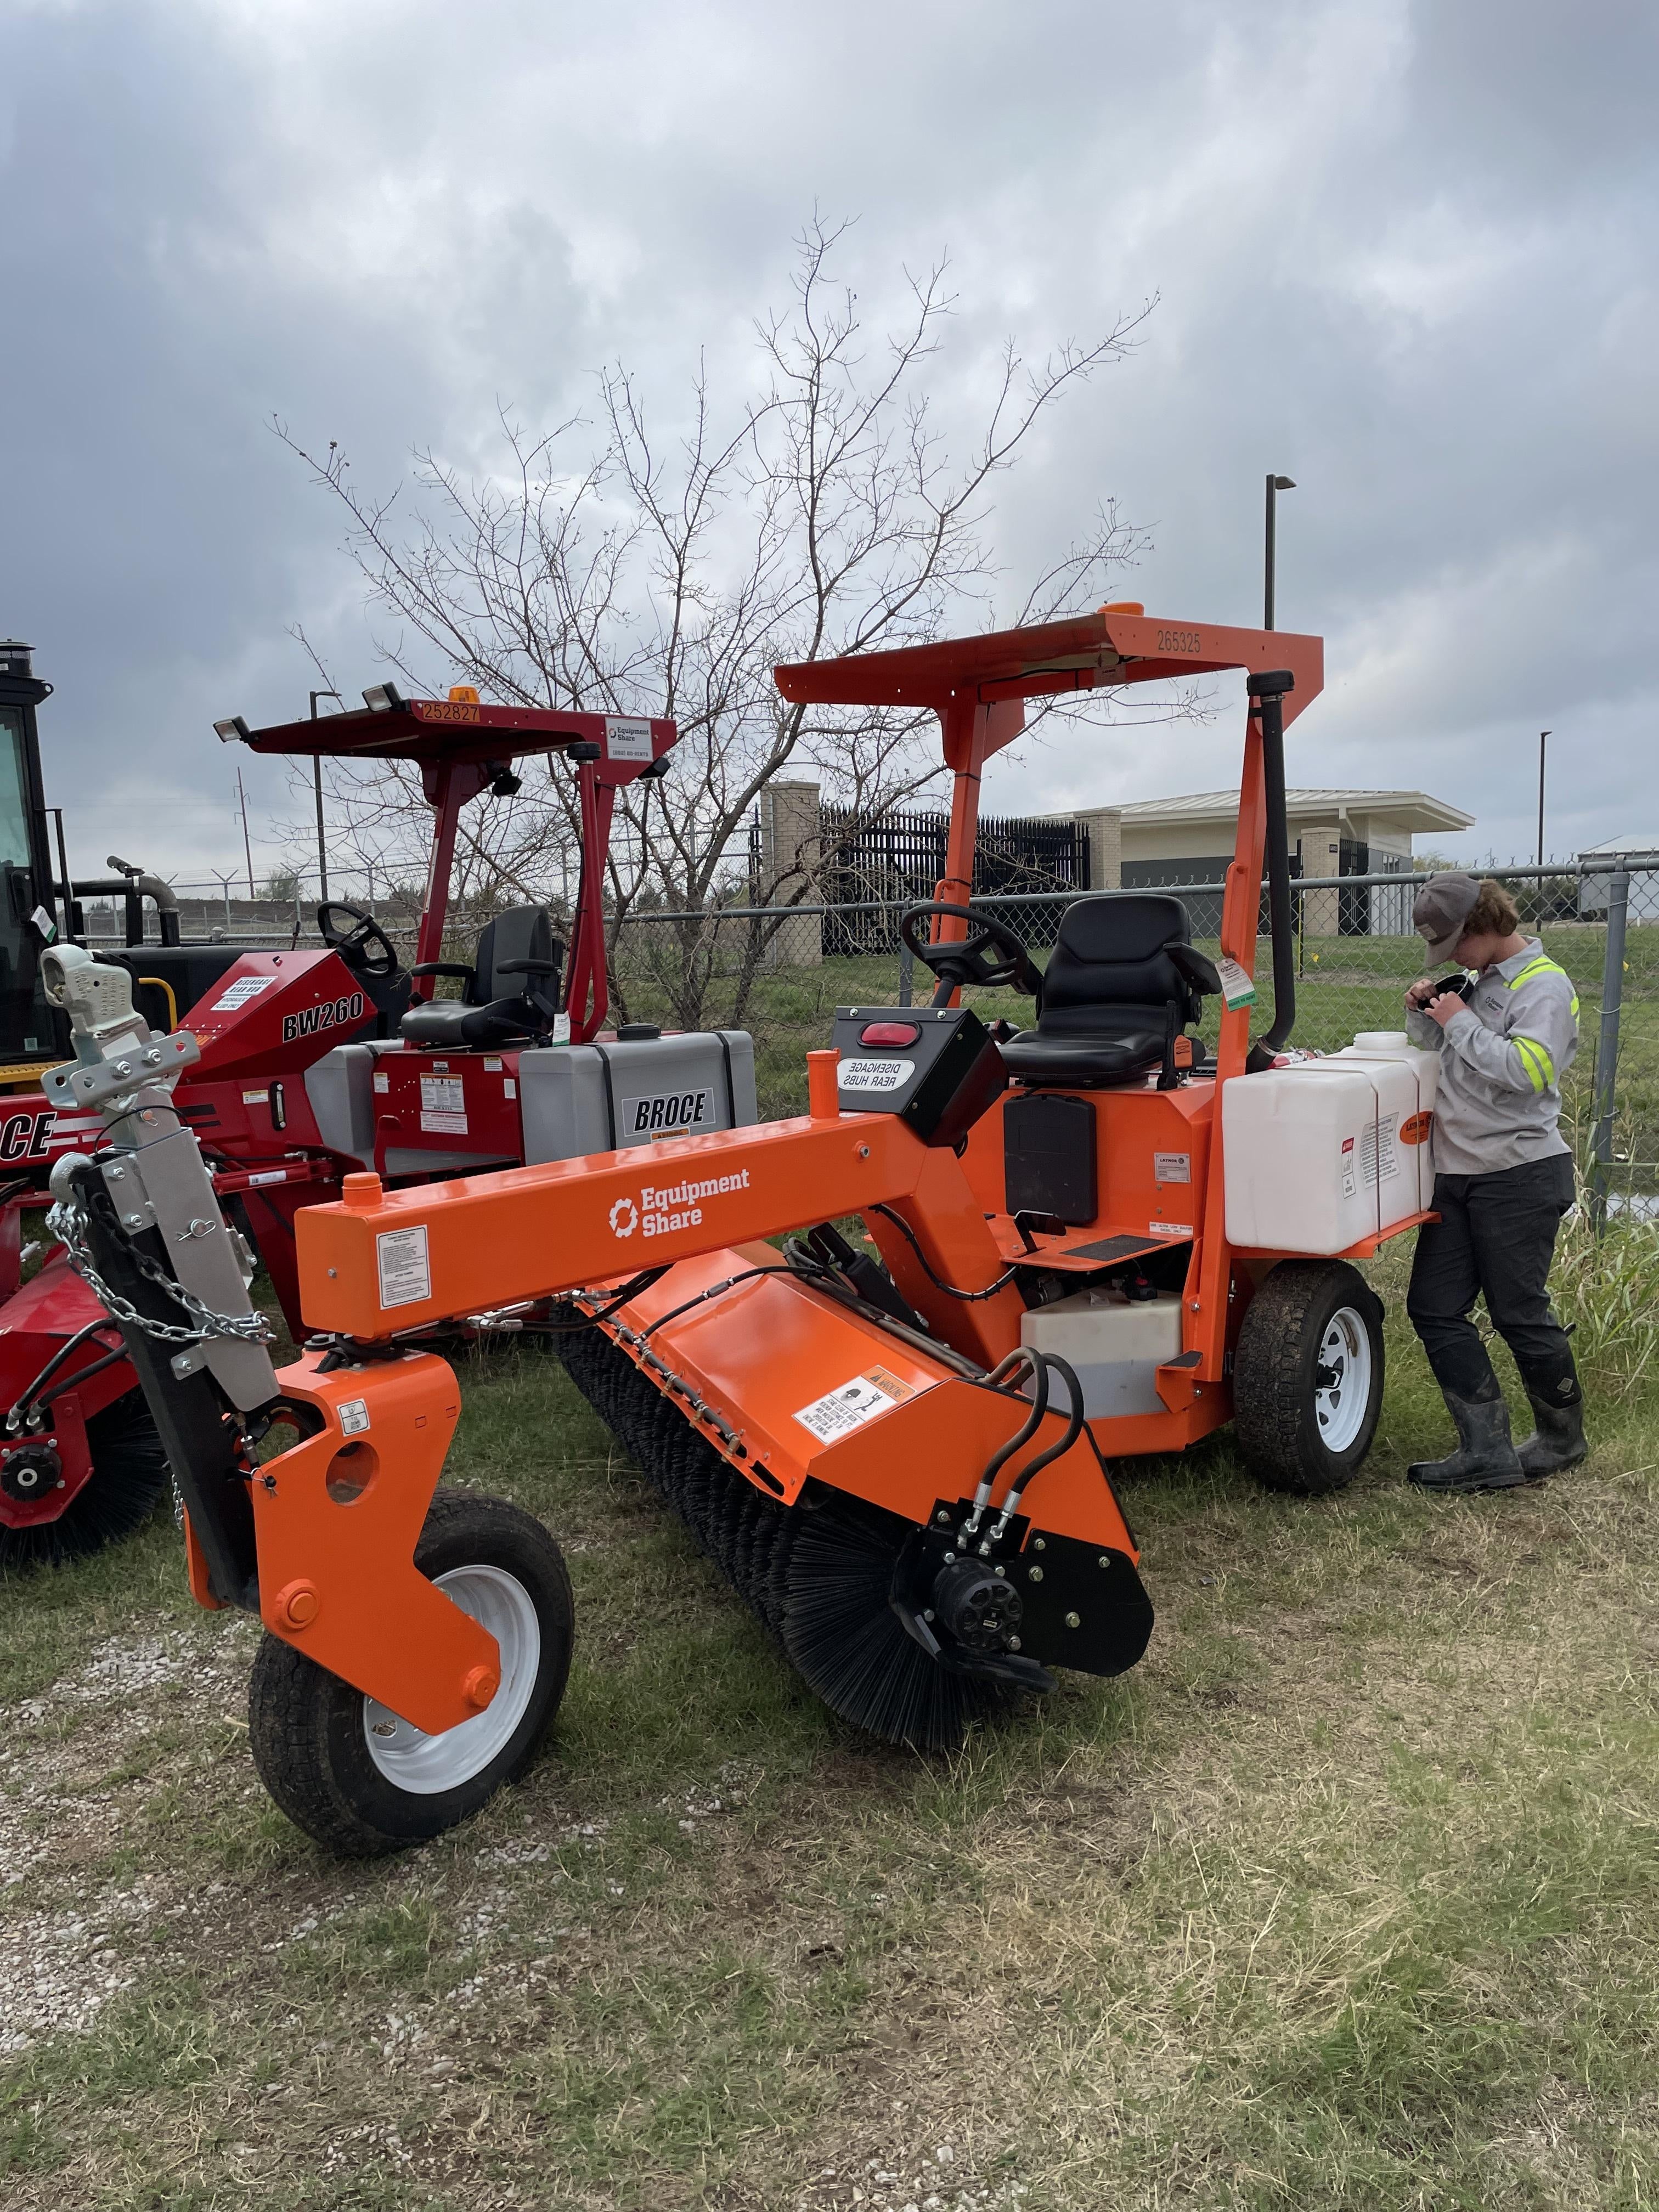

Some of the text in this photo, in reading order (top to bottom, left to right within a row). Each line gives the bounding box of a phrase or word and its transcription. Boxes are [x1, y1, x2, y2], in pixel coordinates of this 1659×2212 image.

[1158, 630, 1201, 653] 265325
[424, 704, 478, 720] 252827
[617, 727, 649, 736] Equipment
[283, 992, 363, 1043] BW260
[633, 1092, 707, 1132] BROCE
[0, 1111, 58, 1161] CE
[641, 1169, 749, 1211] Equipment
[642, 1208, 702, 1237] Share
[878, 1379, 904, 1397] WARNING
